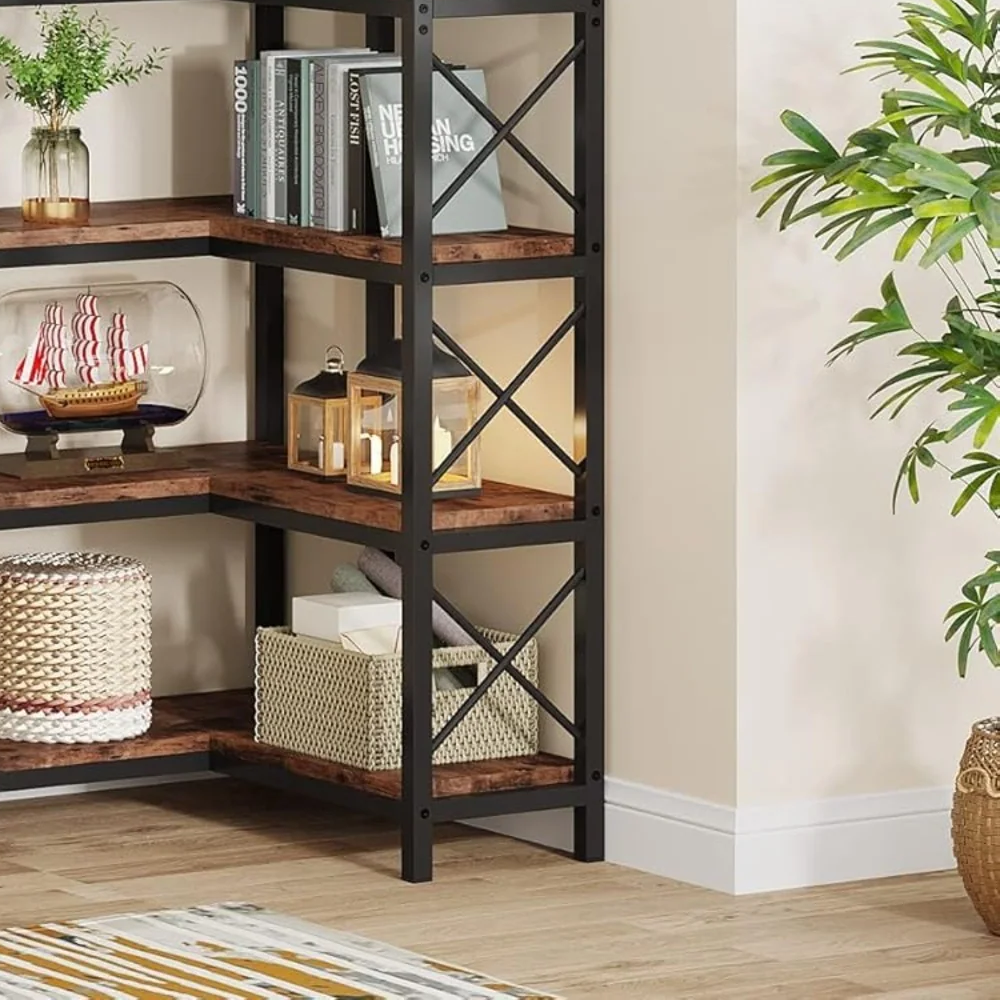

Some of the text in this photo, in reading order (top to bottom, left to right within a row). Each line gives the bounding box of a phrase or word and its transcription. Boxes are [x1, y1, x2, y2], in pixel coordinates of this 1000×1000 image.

[234, 66, 248, 113] 1000
[350, 73, 360, 145] LOST FISH
